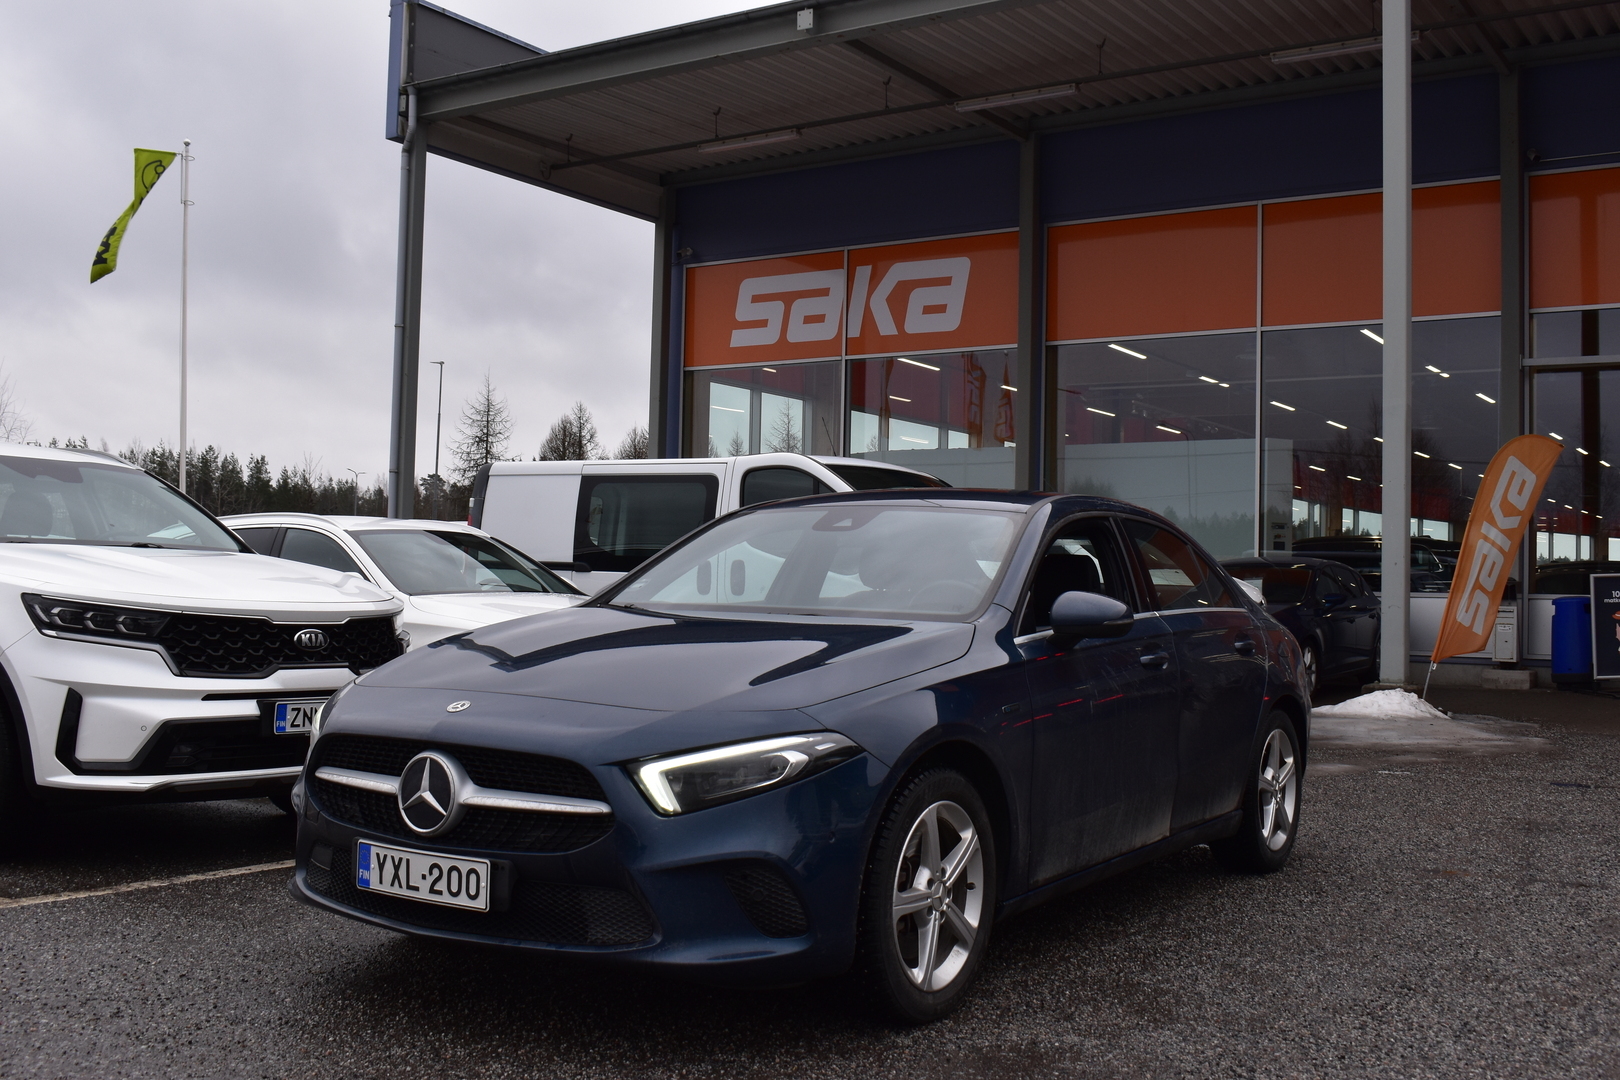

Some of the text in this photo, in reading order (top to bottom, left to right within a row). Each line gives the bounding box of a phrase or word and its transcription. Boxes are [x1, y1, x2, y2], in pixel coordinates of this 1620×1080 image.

[300, 633, 325, 647] KIA
[290, 706, 319, 728] ZN
[359, 868, 370, 880] FIN
[375, 852, 481, 901] YXL-200
